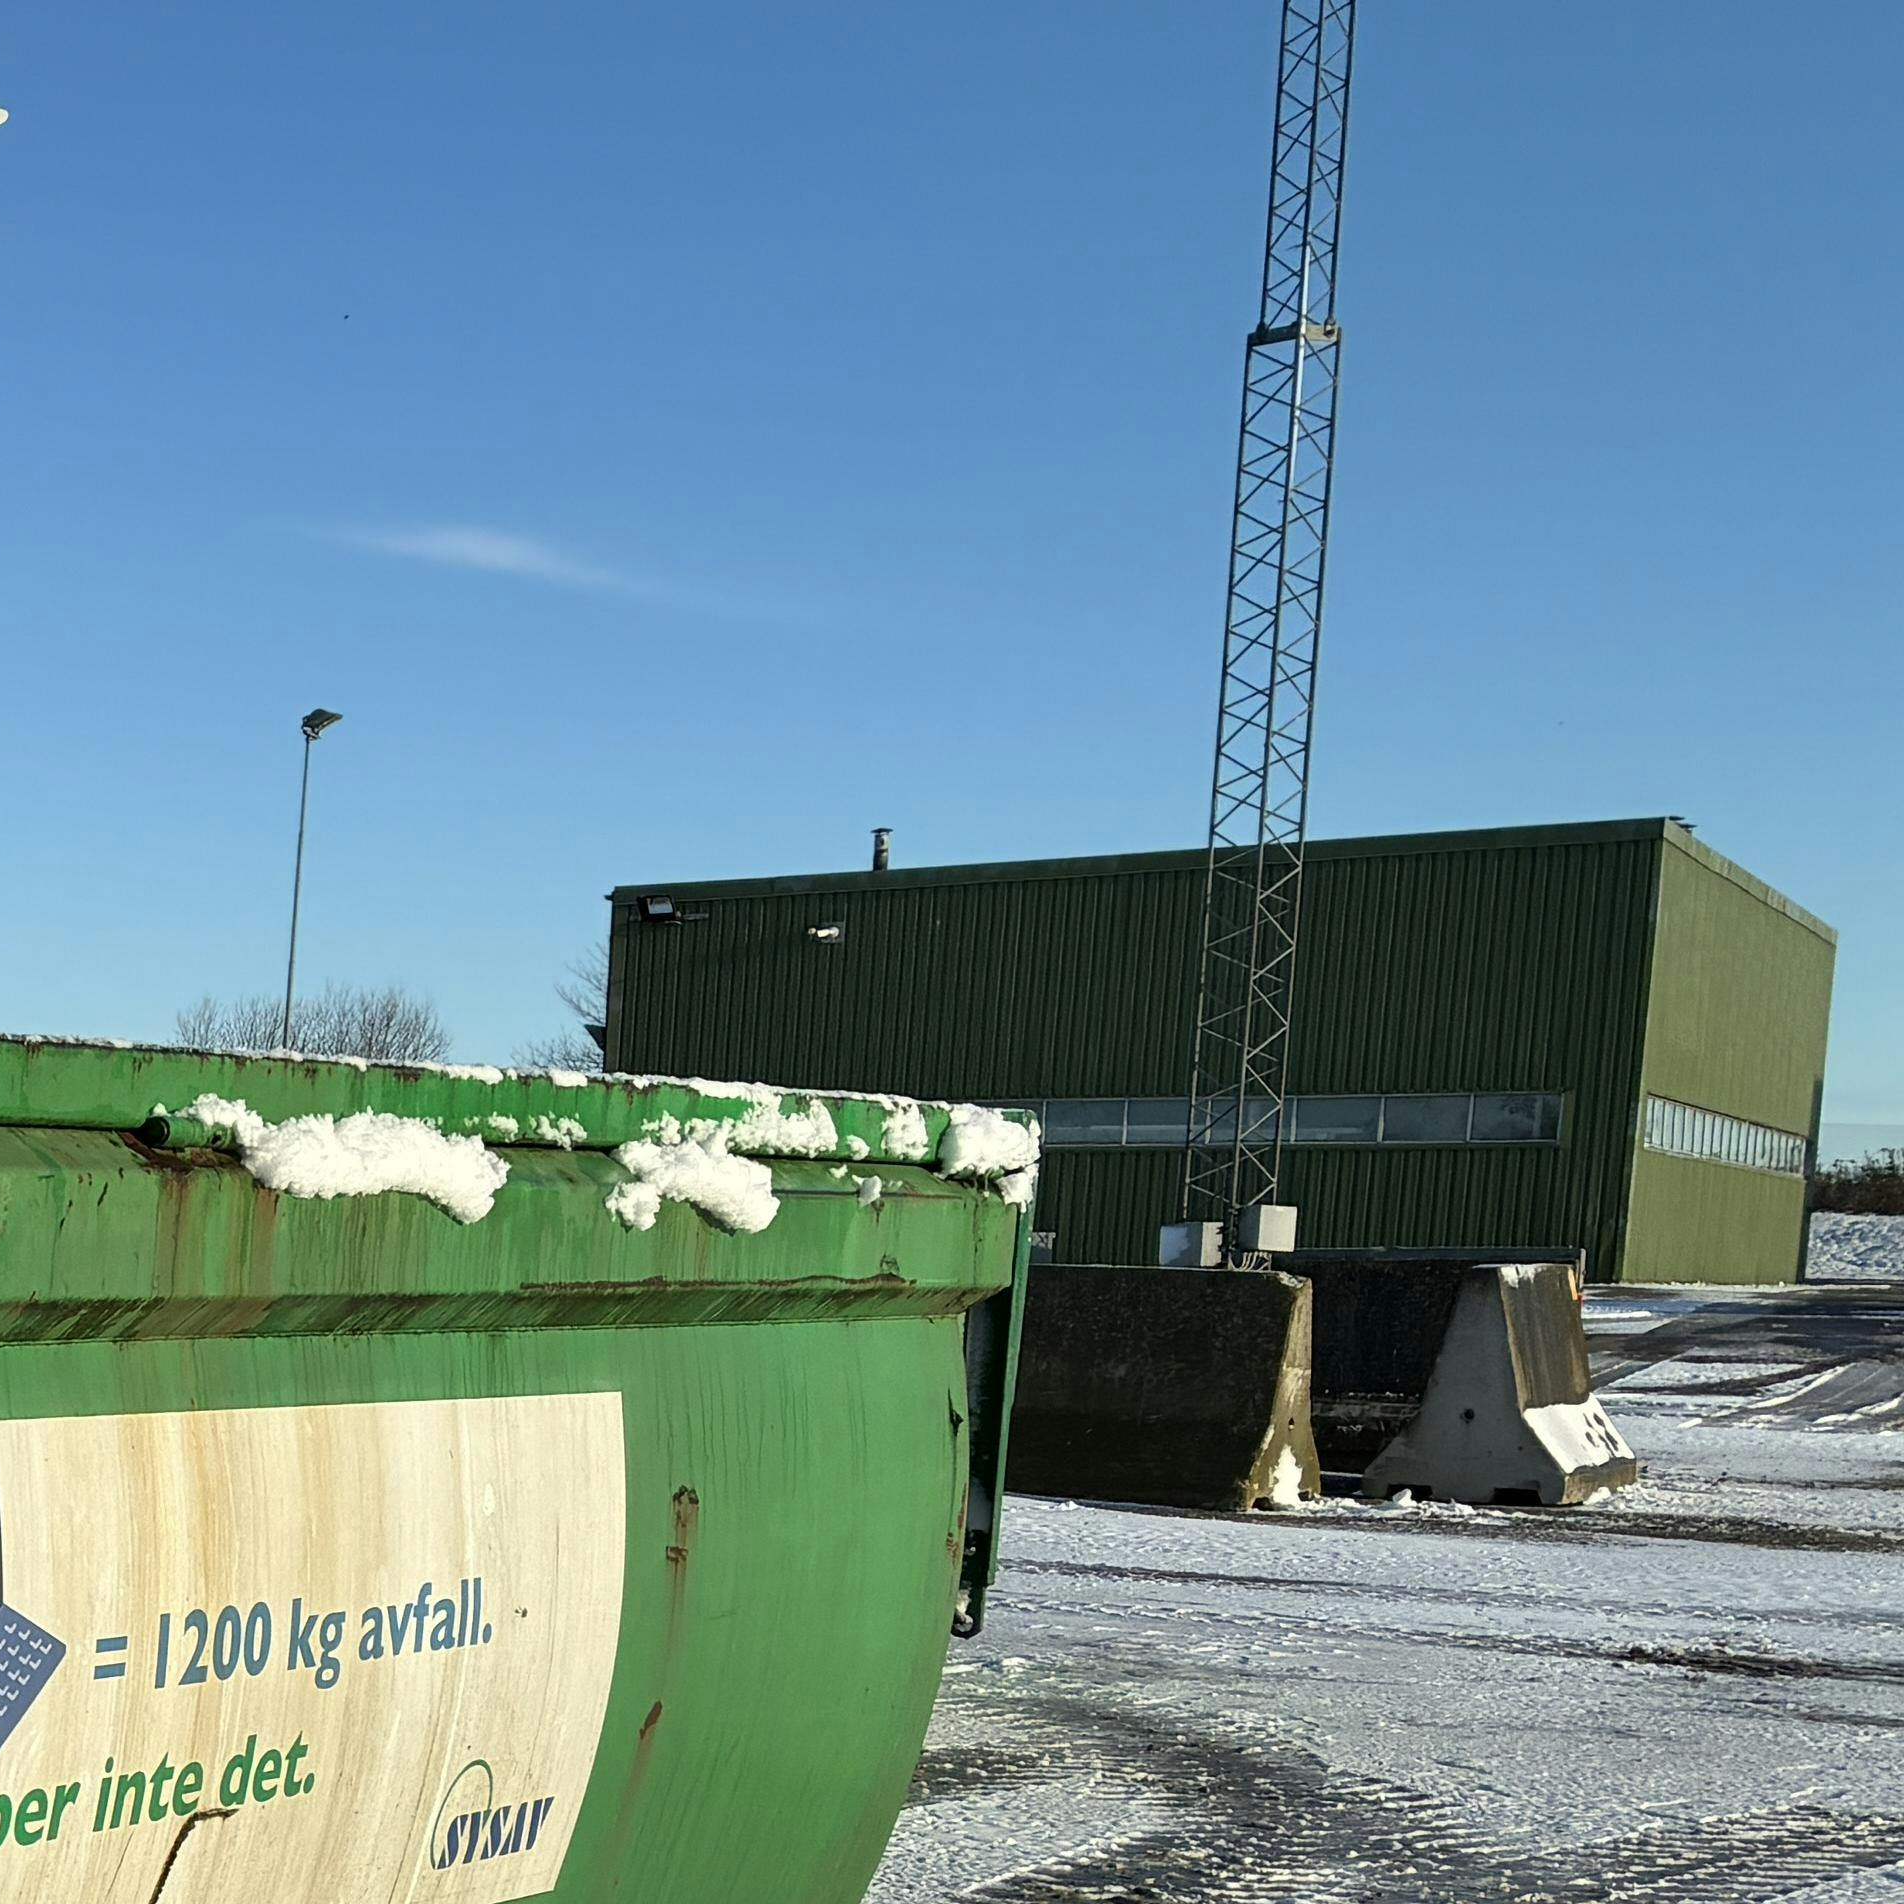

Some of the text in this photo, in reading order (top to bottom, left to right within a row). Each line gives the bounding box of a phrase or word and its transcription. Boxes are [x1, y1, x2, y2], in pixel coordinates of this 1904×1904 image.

[154, 1601, 272, 1690] 1200
[287, 1597, 347, 1690] kg
[358, 1576, 492, 1662] avfall.
[92, 1752, 204, 1833] inte
[218, 1730, 315, 1808] det.
[435, 1796, 556, 1871] SYSAV
